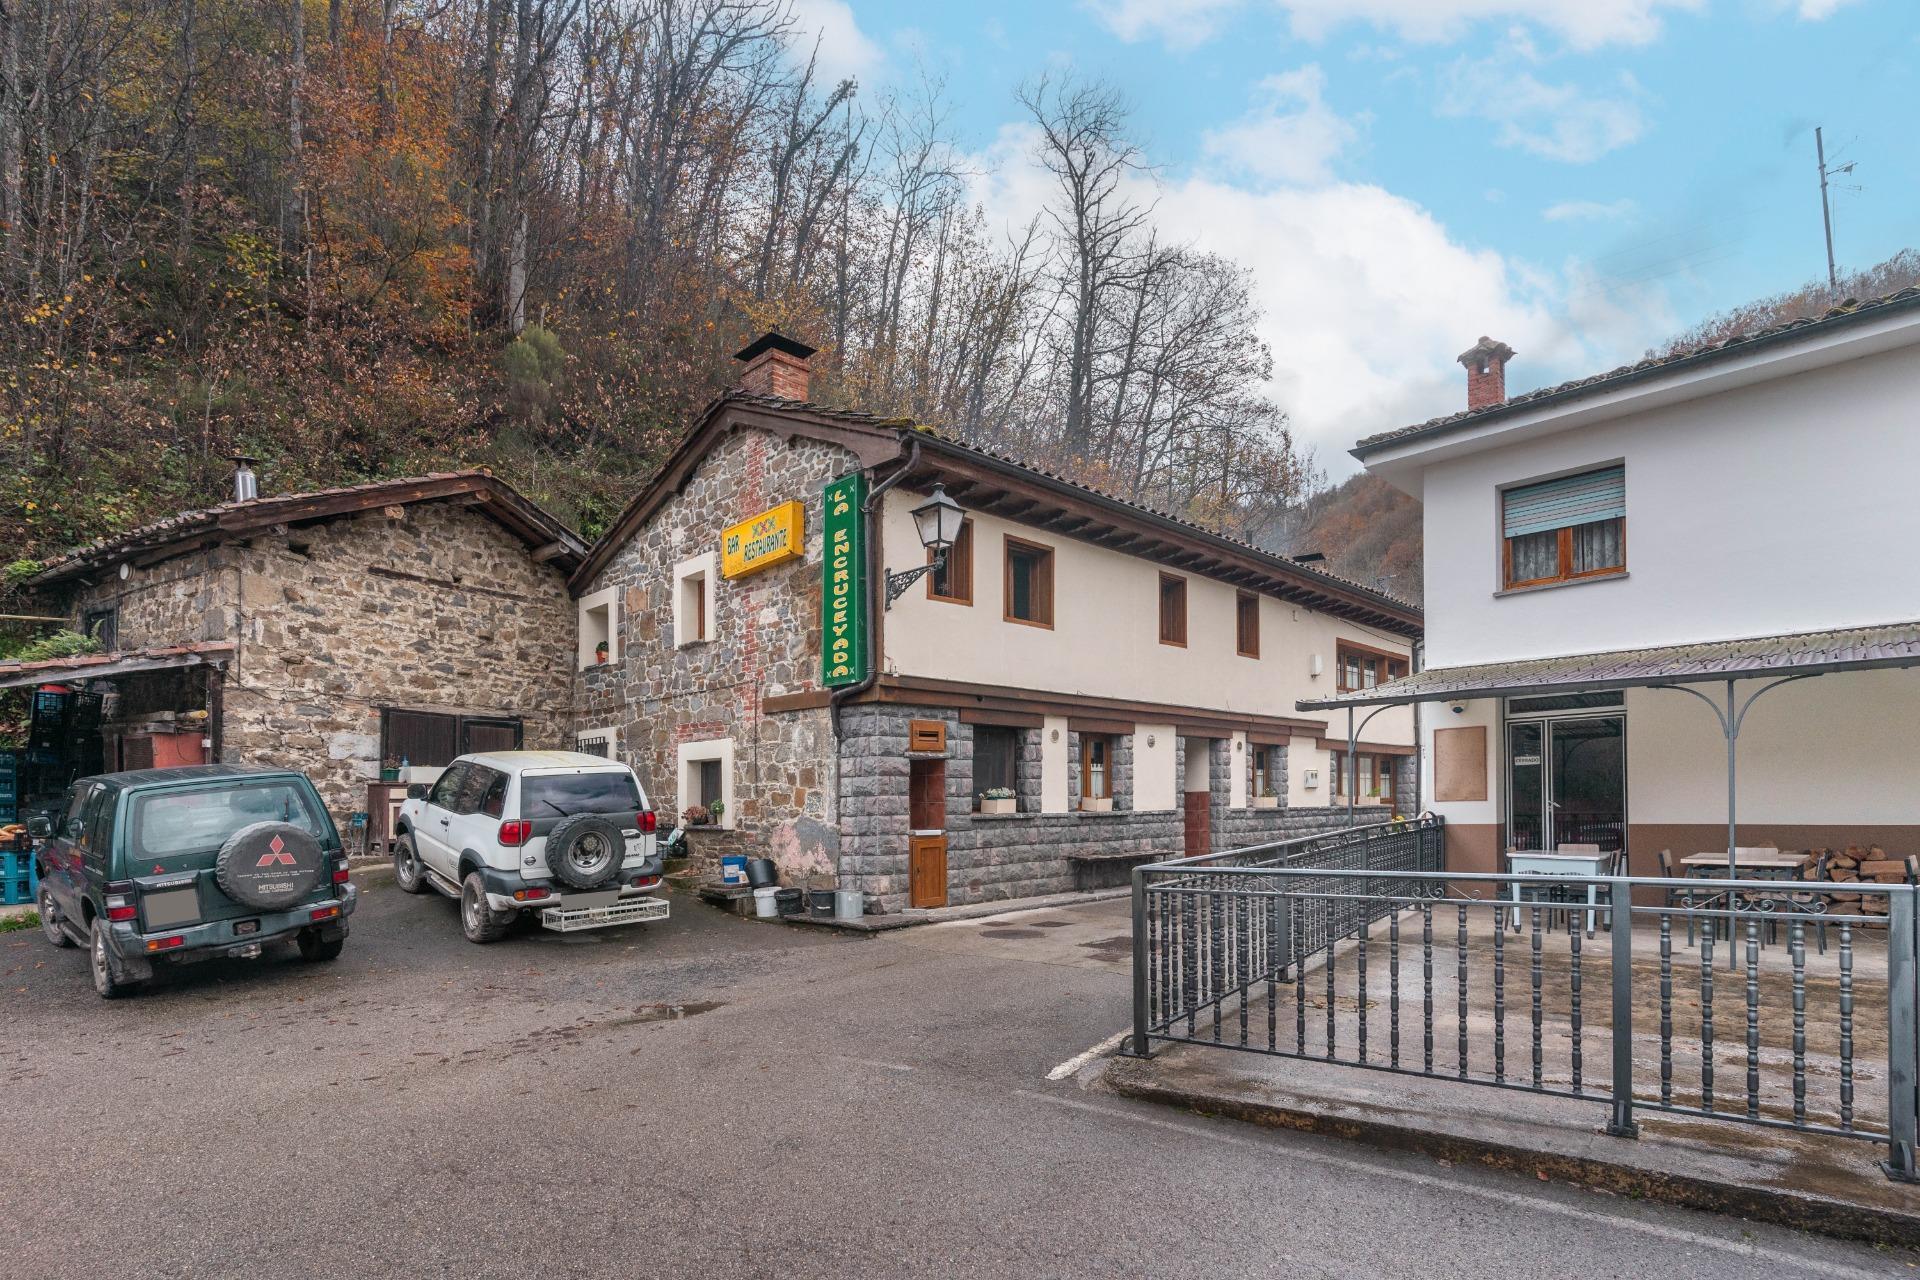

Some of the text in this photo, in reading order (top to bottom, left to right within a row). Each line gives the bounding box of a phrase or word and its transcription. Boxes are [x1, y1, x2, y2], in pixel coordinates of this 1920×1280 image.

[833, 489, 849, 516] LA
[727, 529, 786, 562] BAR RESTAURANTE
[258, 882, 294, 891] MITSUBISHI
